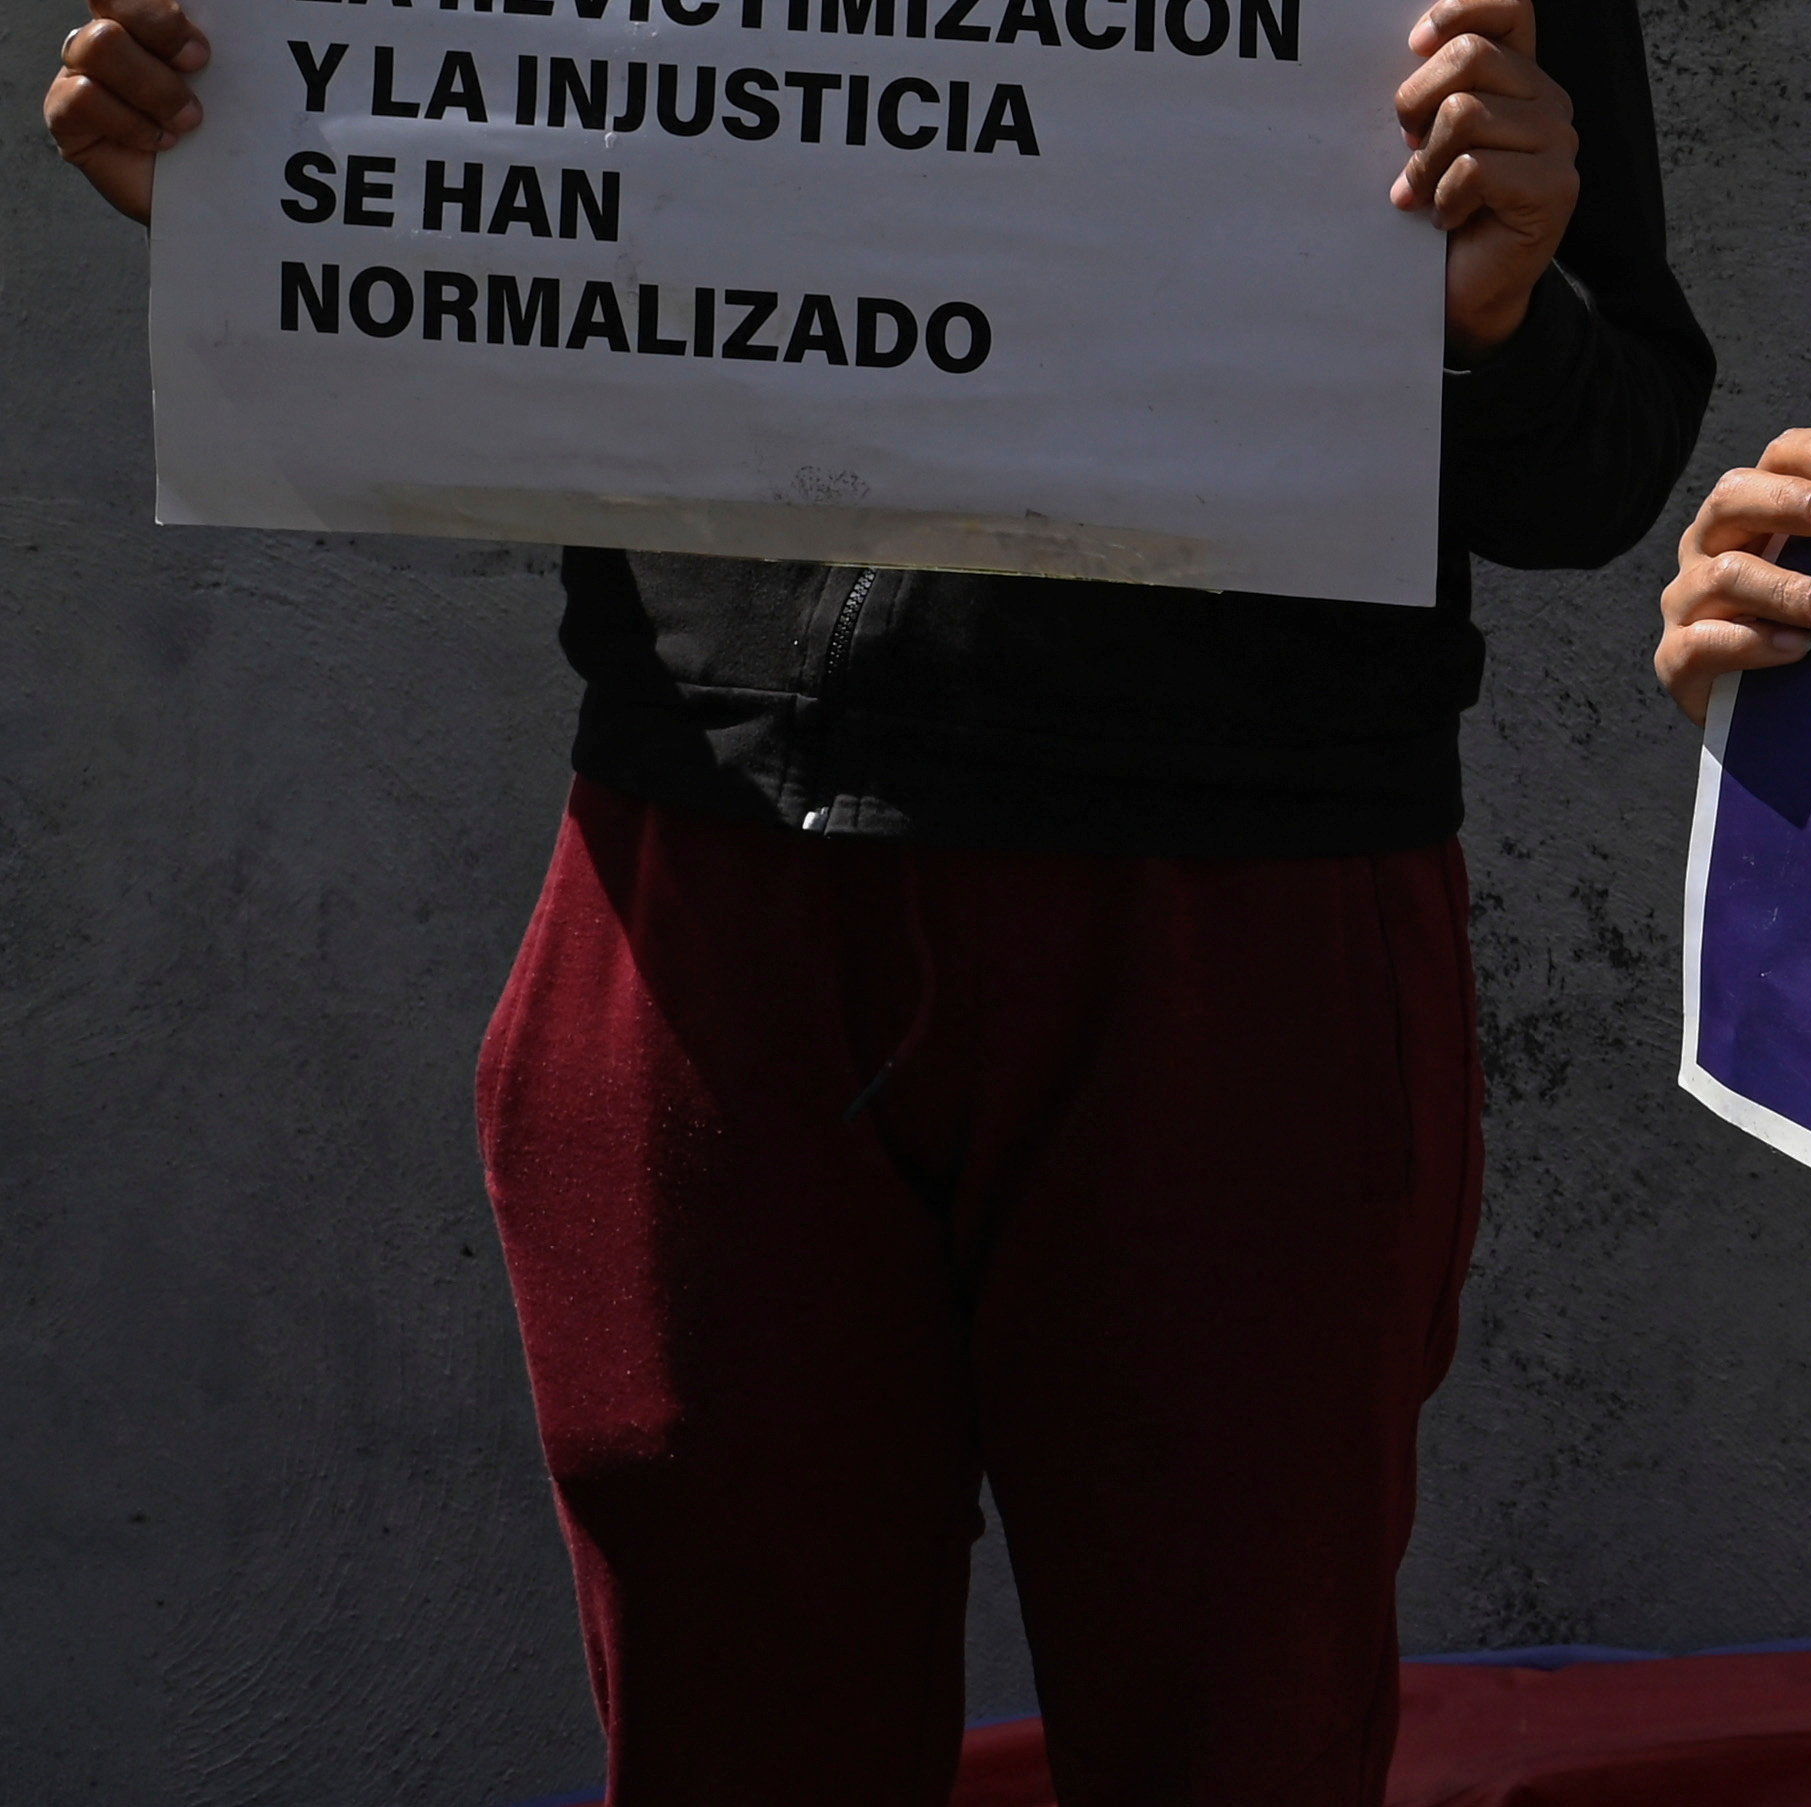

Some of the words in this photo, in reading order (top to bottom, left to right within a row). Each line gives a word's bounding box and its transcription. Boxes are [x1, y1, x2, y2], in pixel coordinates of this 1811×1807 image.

[287, 41, 350, 113] Y
[371, 45, 488, 123] LA
[515, 54, 1041, 157] INJUSTICIA
[280, 151, 396, 228] SE
[422, 159, 621, 243] HAN
[280, 261, 992, 375] NORMALIZADO
